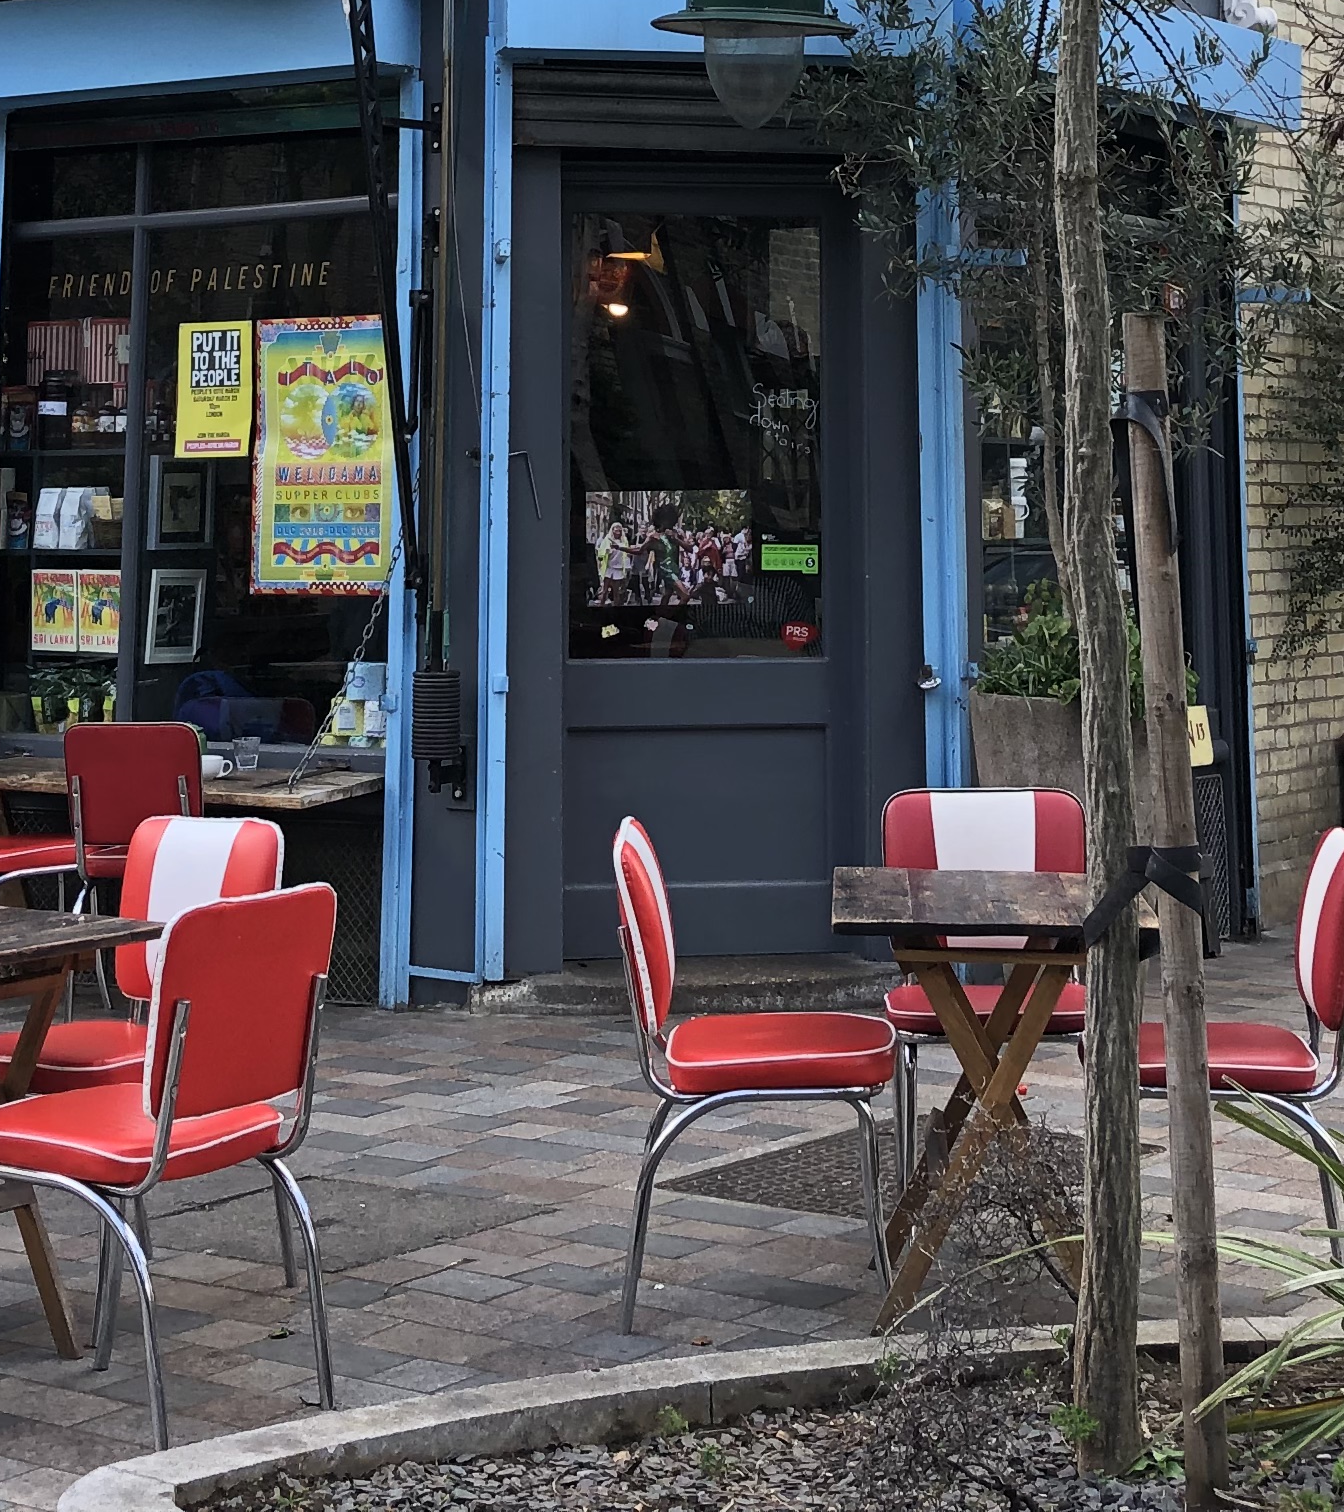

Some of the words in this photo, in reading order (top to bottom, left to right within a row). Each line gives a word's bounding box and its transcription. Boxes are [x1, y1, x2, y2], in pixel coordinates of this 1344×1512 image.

[150, 269, 176, 294] OF
[190, 261, 331, 292] PALESTINE
[192, 332, 222, 352] PUT
[226, 330, 240, 350] IT
[192, 352, 209, 370] TO
[213, 350, 240, 369] THE
[191, 369, 240, 387] PEOPLE
[749, 383, 819, 429] Seating
[750, 401, 790, 433] down
[276, 490, 328, 501] SUPPER
[336, 489, 379, 500] CLUBS
[807, 558, 814, 567] 5
[33, 634, 47, 644] SRI
[50, 634, 74, 645] LANKA
[786, 625, 809, 637] PRS
